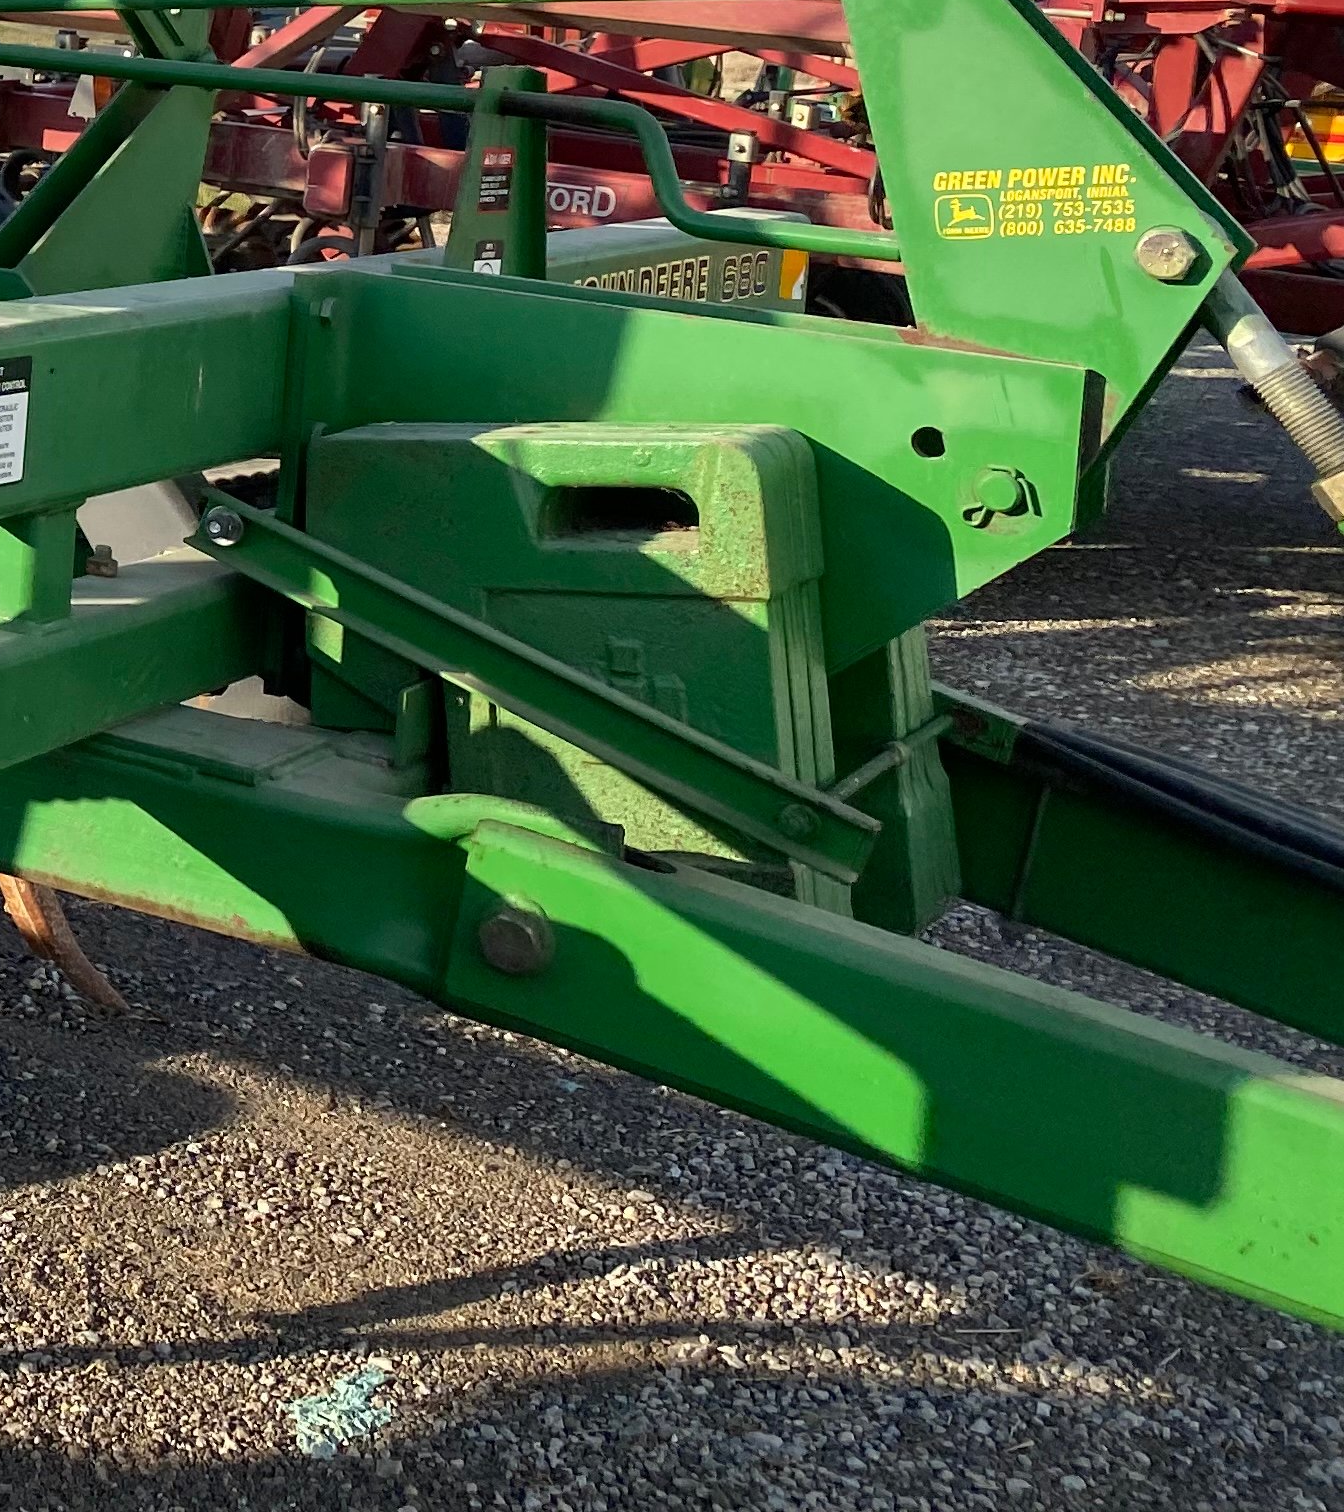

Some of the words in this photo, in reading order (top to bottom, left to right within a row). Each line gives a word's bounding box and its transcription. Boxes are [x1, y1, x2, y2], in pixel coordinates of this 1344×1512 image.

[933, 170, 1002, 191] GREEN
[1008, 166, 1086, 189] POWER
[1092, 163, 1137, 185] INC.
[998, 202, 1043, 220] (219)
[1052, 199, 1135, 217] 753-7535
[999, 221, 1044, 237] (800)
